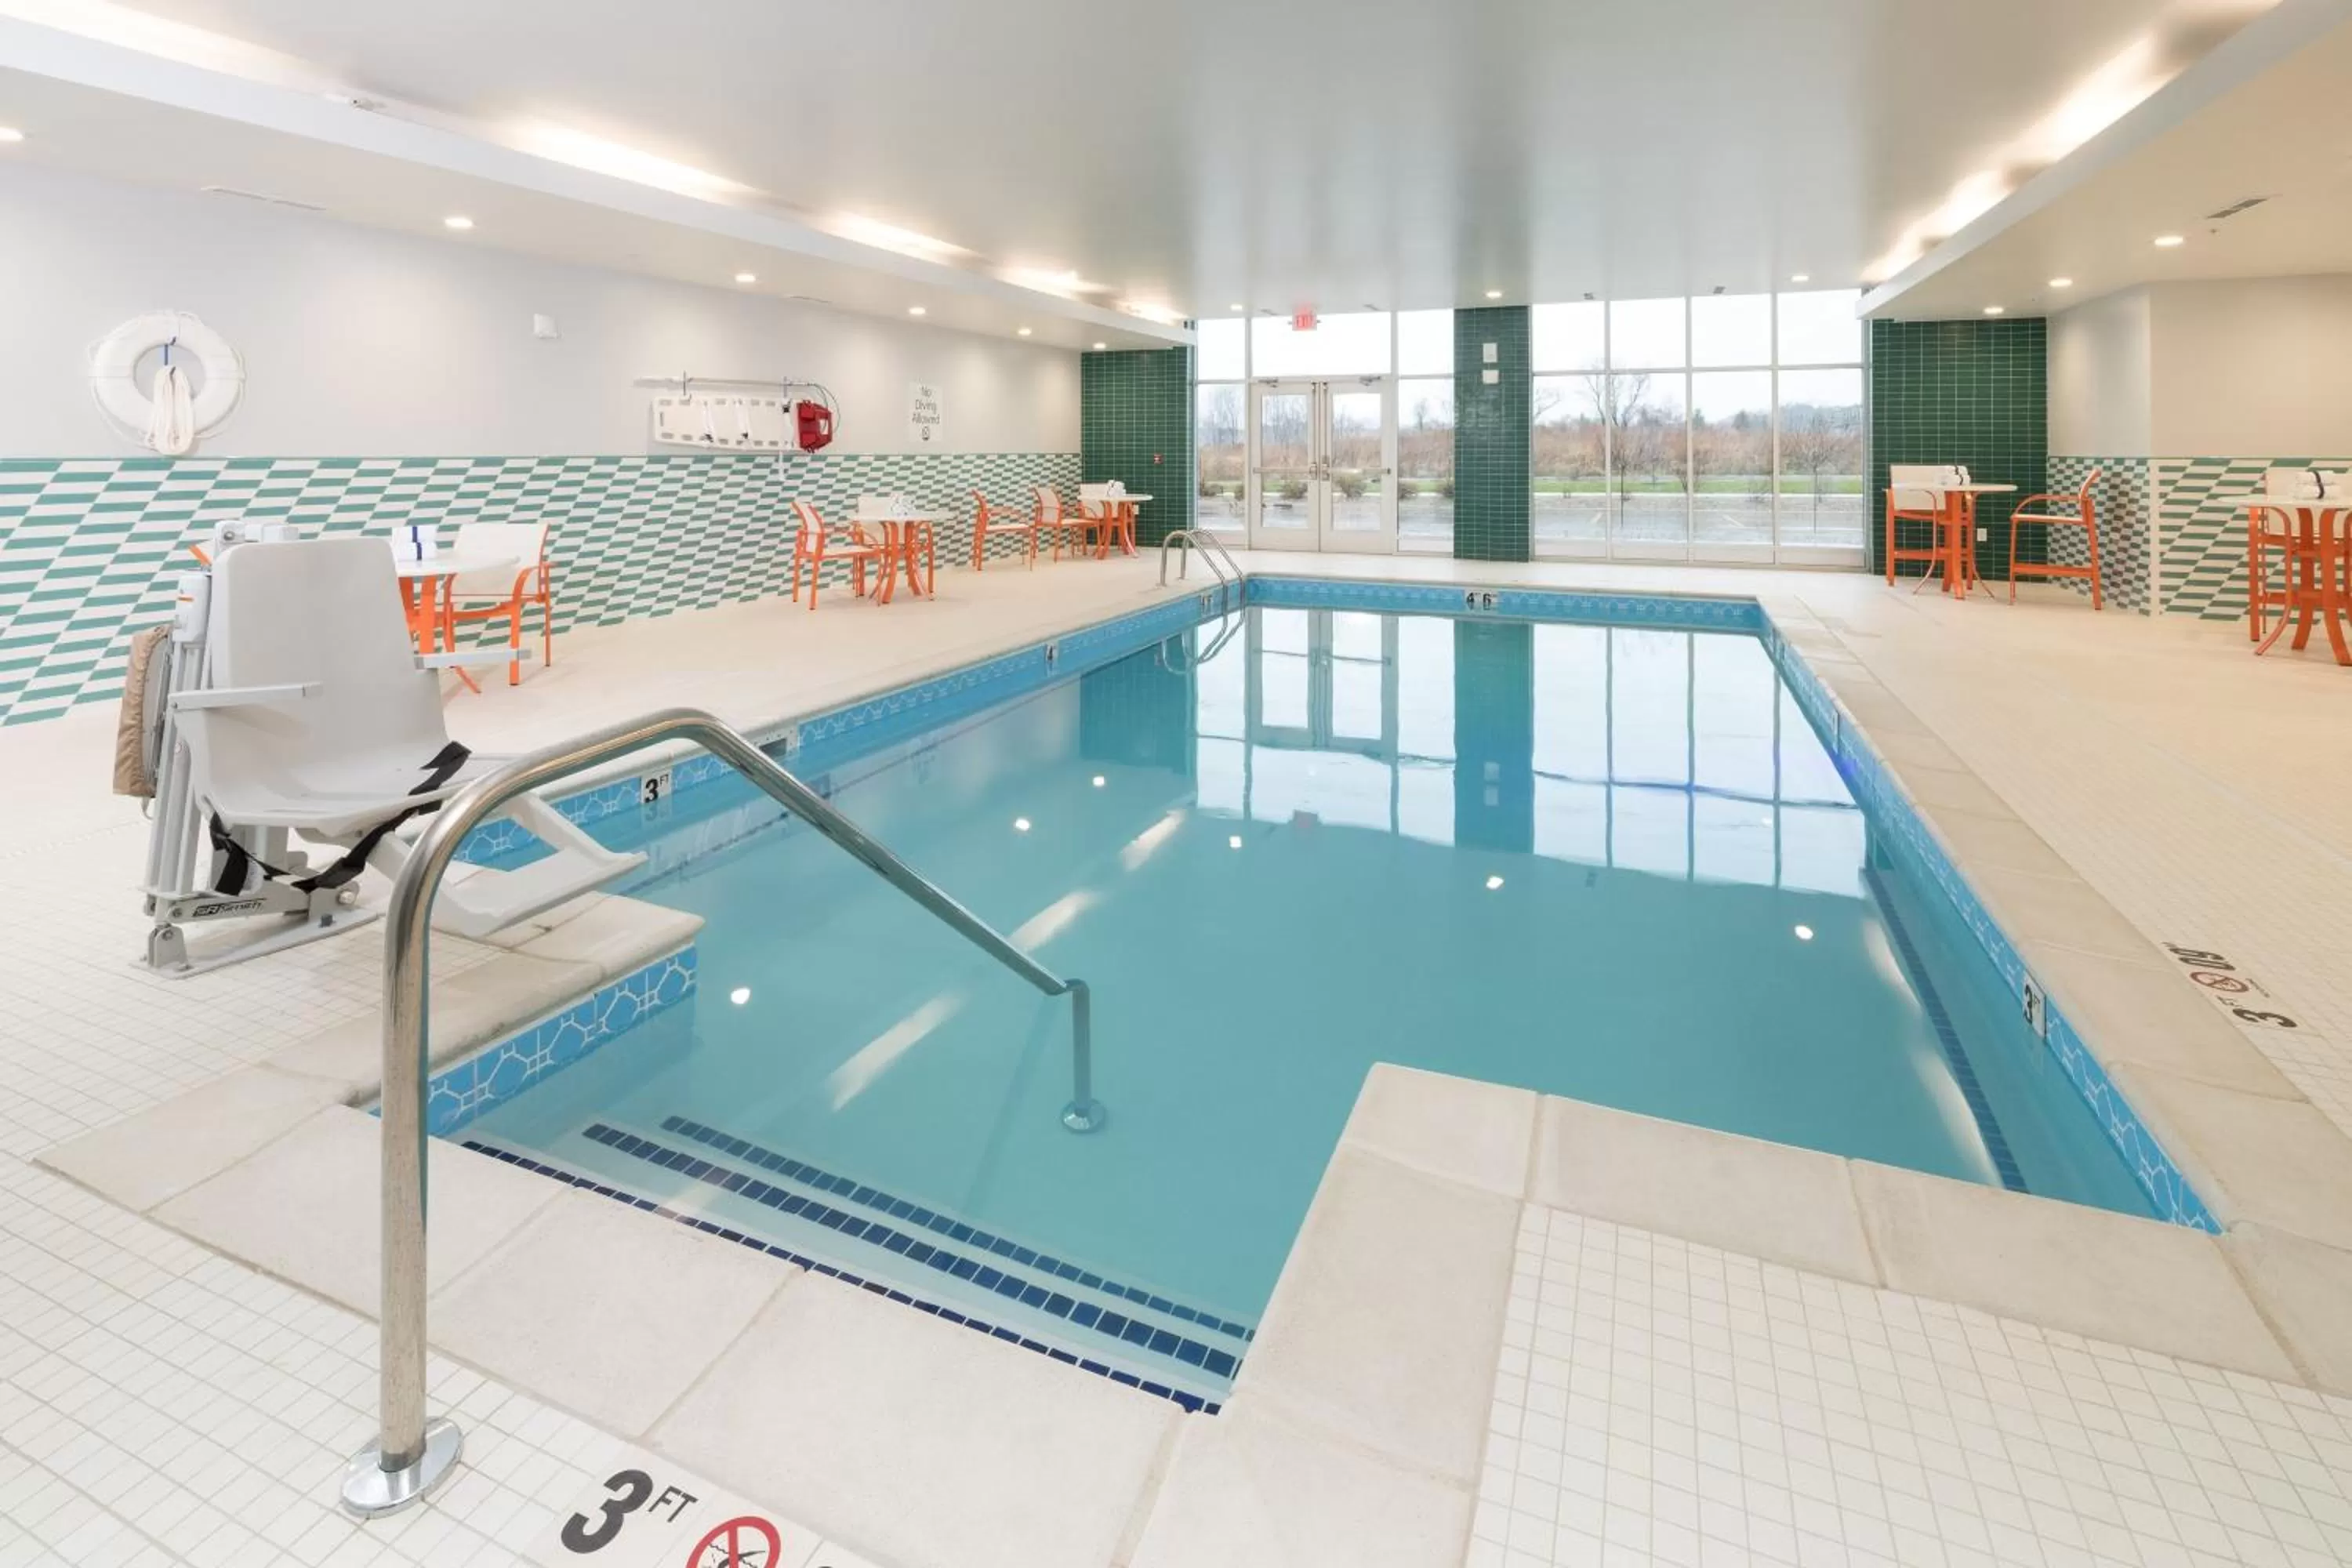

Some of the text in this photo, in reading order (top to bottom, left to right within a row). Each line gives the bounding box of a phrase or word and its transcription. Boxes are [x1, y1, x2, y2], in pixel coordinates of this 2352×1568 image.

[915, 399, 936, 415] Diving
[912, 412, 940, 424] Allowed
[645, 778, 659, 803] 3
[561, 1468, 698, 1555] 3 FT
